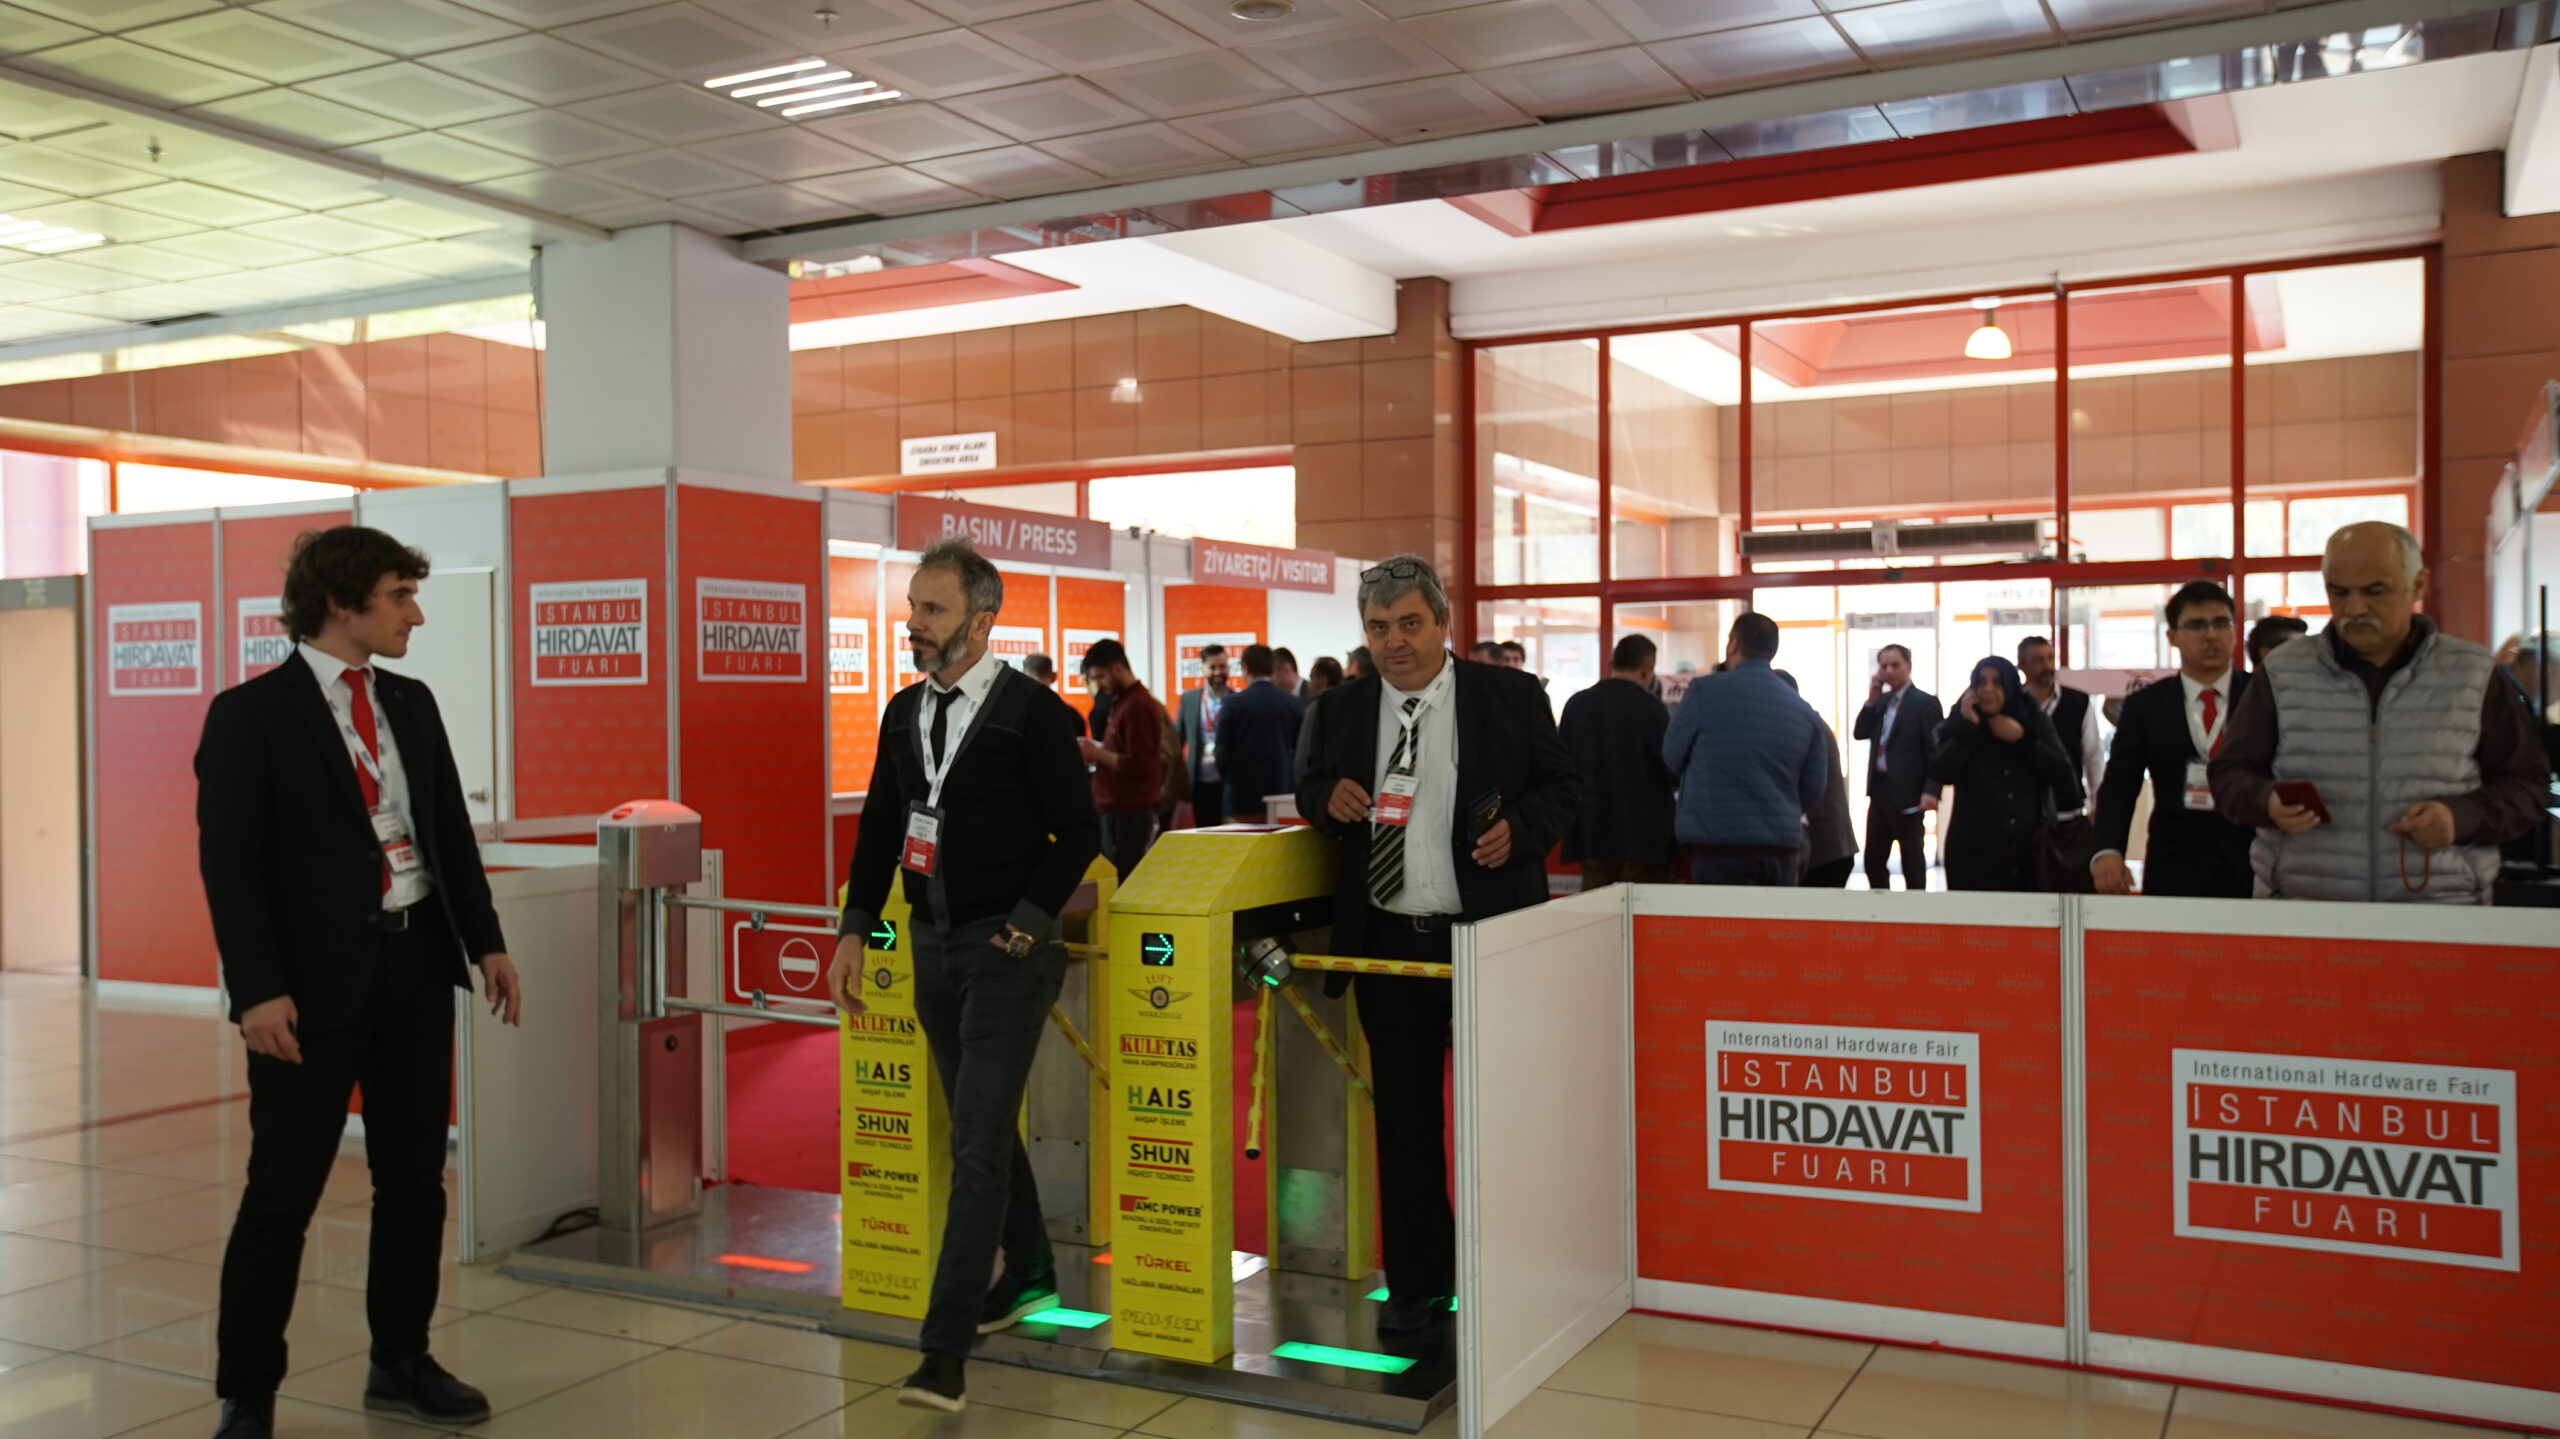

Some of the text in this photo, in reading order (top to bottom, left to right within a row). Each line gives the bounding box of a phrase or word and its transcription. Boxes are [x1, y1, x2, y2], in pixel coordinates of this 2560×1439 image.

[942, 513, 1077, 555] BASIN / PRESS
[537, 626, 641, 655] HIRDAVAT
[703, 624, 801, 652] HIRDAVAT
[113, 643, 196, 669] HIRDAVAT
[559, 656, 619, 674] FUARI
[725, 654, 782, 672] FUARI
[1144, 974, 1174, 985] LUFT
[1723, 1031, 1959, 1057] International Hardware Fair
[855, 1060, 911, 1082] HAIS
[2194, 1061, 2491, 1096] International Hardware Fair
[1128, 1085, 1192, 1109] HAIS
[857, 1114, 909, 1135] SHUN
[1720, 1096, 1965, 1154] HIRDAVAT
[1130, 1143, 1190, 1165] SHUN
[862, 1168, 919, 1184] AMC POWER
[1772, 1151, 1910, 1187] FUARI
[2190, 1134, 2498, 1205] HIRDAVAT
[1136, 1201, 1201, 1218] AMC POWER
[2255, 1196, 2427, 1240] FUARI
[861, 1217, 911, 1235] TÜRKEL
[1134, 1253, 1192, 1273] TÜRKEL
